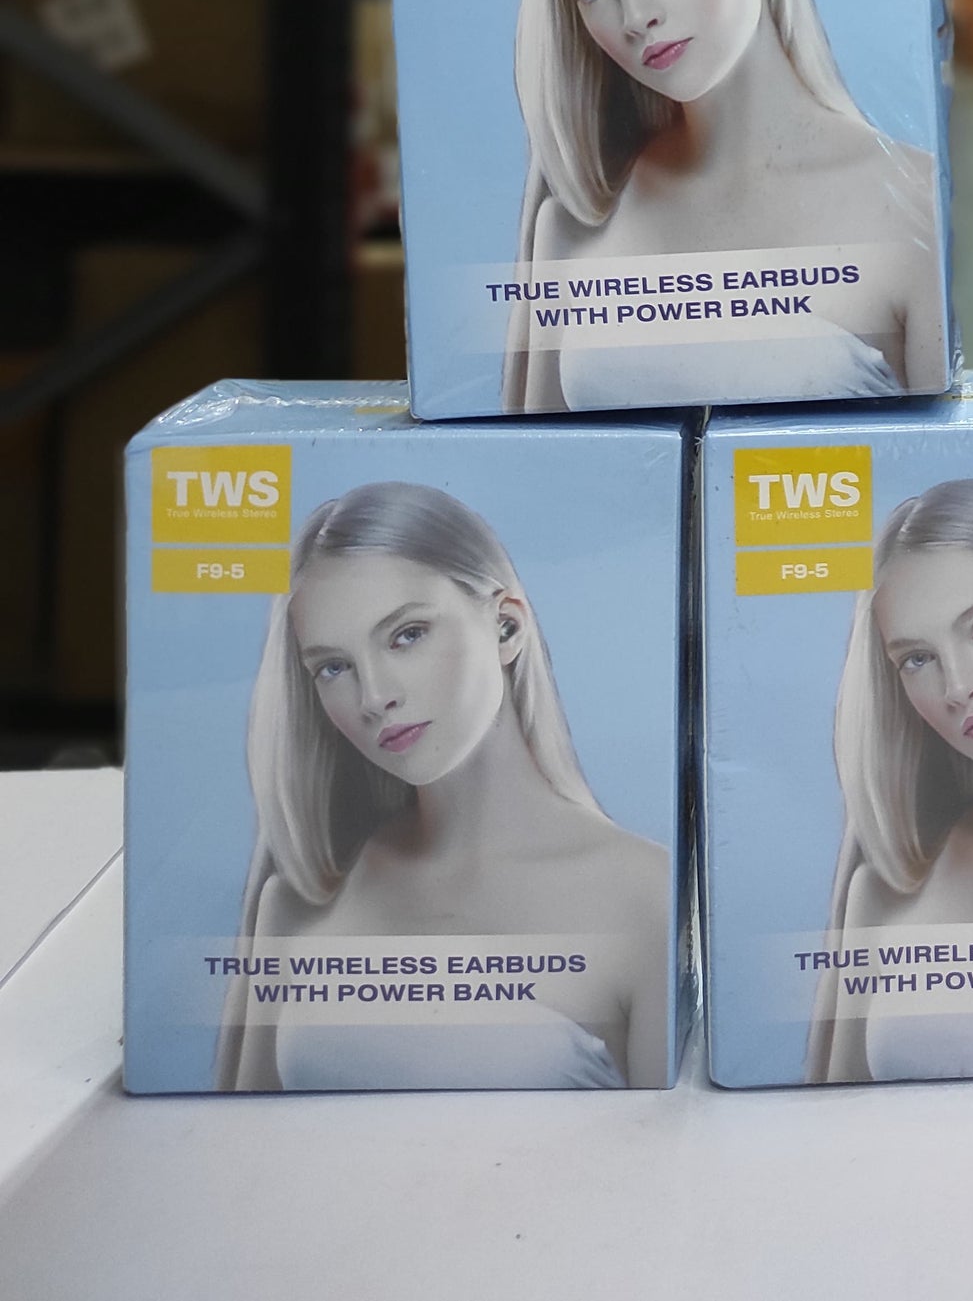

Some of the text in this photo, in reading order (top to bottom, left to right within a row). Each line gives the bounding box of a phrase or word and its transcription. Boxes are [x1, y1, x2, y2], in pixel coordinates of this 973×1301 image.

[486, 265, 860, 301] TRUE WIRELESS EARBUDS
[535, 295, 812, 328] WITH POWER BANK
[166, 470, 280, 508] TWS
[748, 471, 861, 510] TWS
[166, 508, 277, 518] True Wireless Stereo
[750, 509, 859, 521] True Wireless Stereo
[196, 563, 245, 580] F9-5
[781, 563, 829, 580] F9-5
[204, 954, 588, 976] TRUE WIRELESS EARBUDS
[794, 948, 869, 971] TRUE
[254, 982, 537, 1003] WITH POWER BANK
[844, 973, 917, 995] WITH
